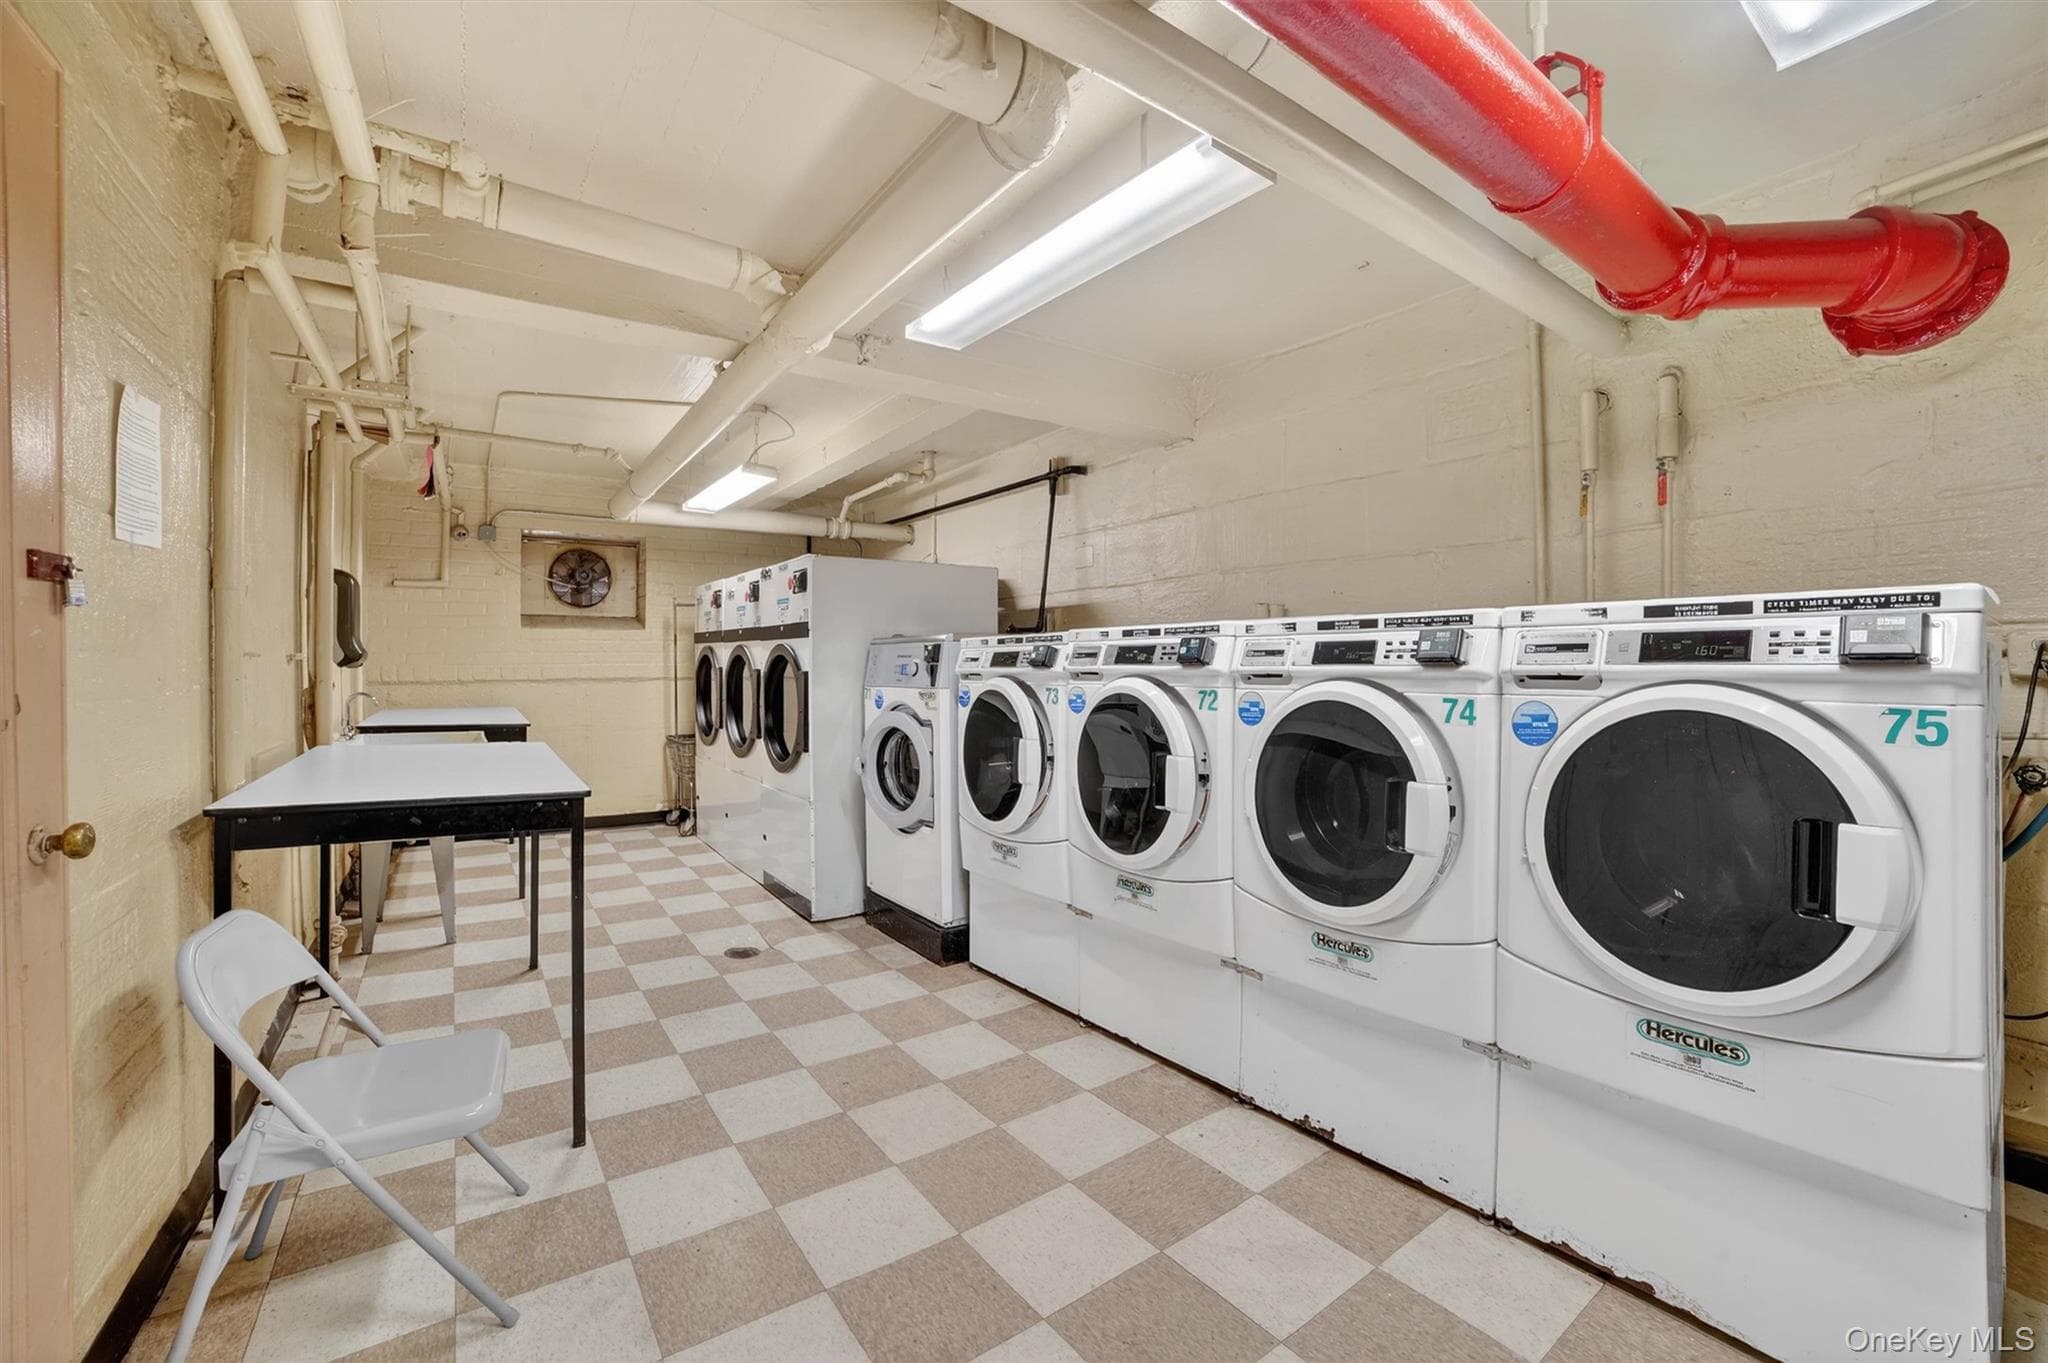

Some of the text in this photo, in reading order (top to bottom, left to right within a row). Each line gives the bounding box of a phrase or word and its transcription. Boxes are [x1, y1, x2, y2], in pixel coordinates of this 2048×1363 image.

[1045, 688, 1059, 705] 73
[1198, 689, 1218, 711] 72
[1442, 697, 1477, 726] 74
[1881, 707, 1949, 747] 75
[1316, 932, 1370, 959] Hercules
[1645, 1019, 1742, 1061] Hercules
